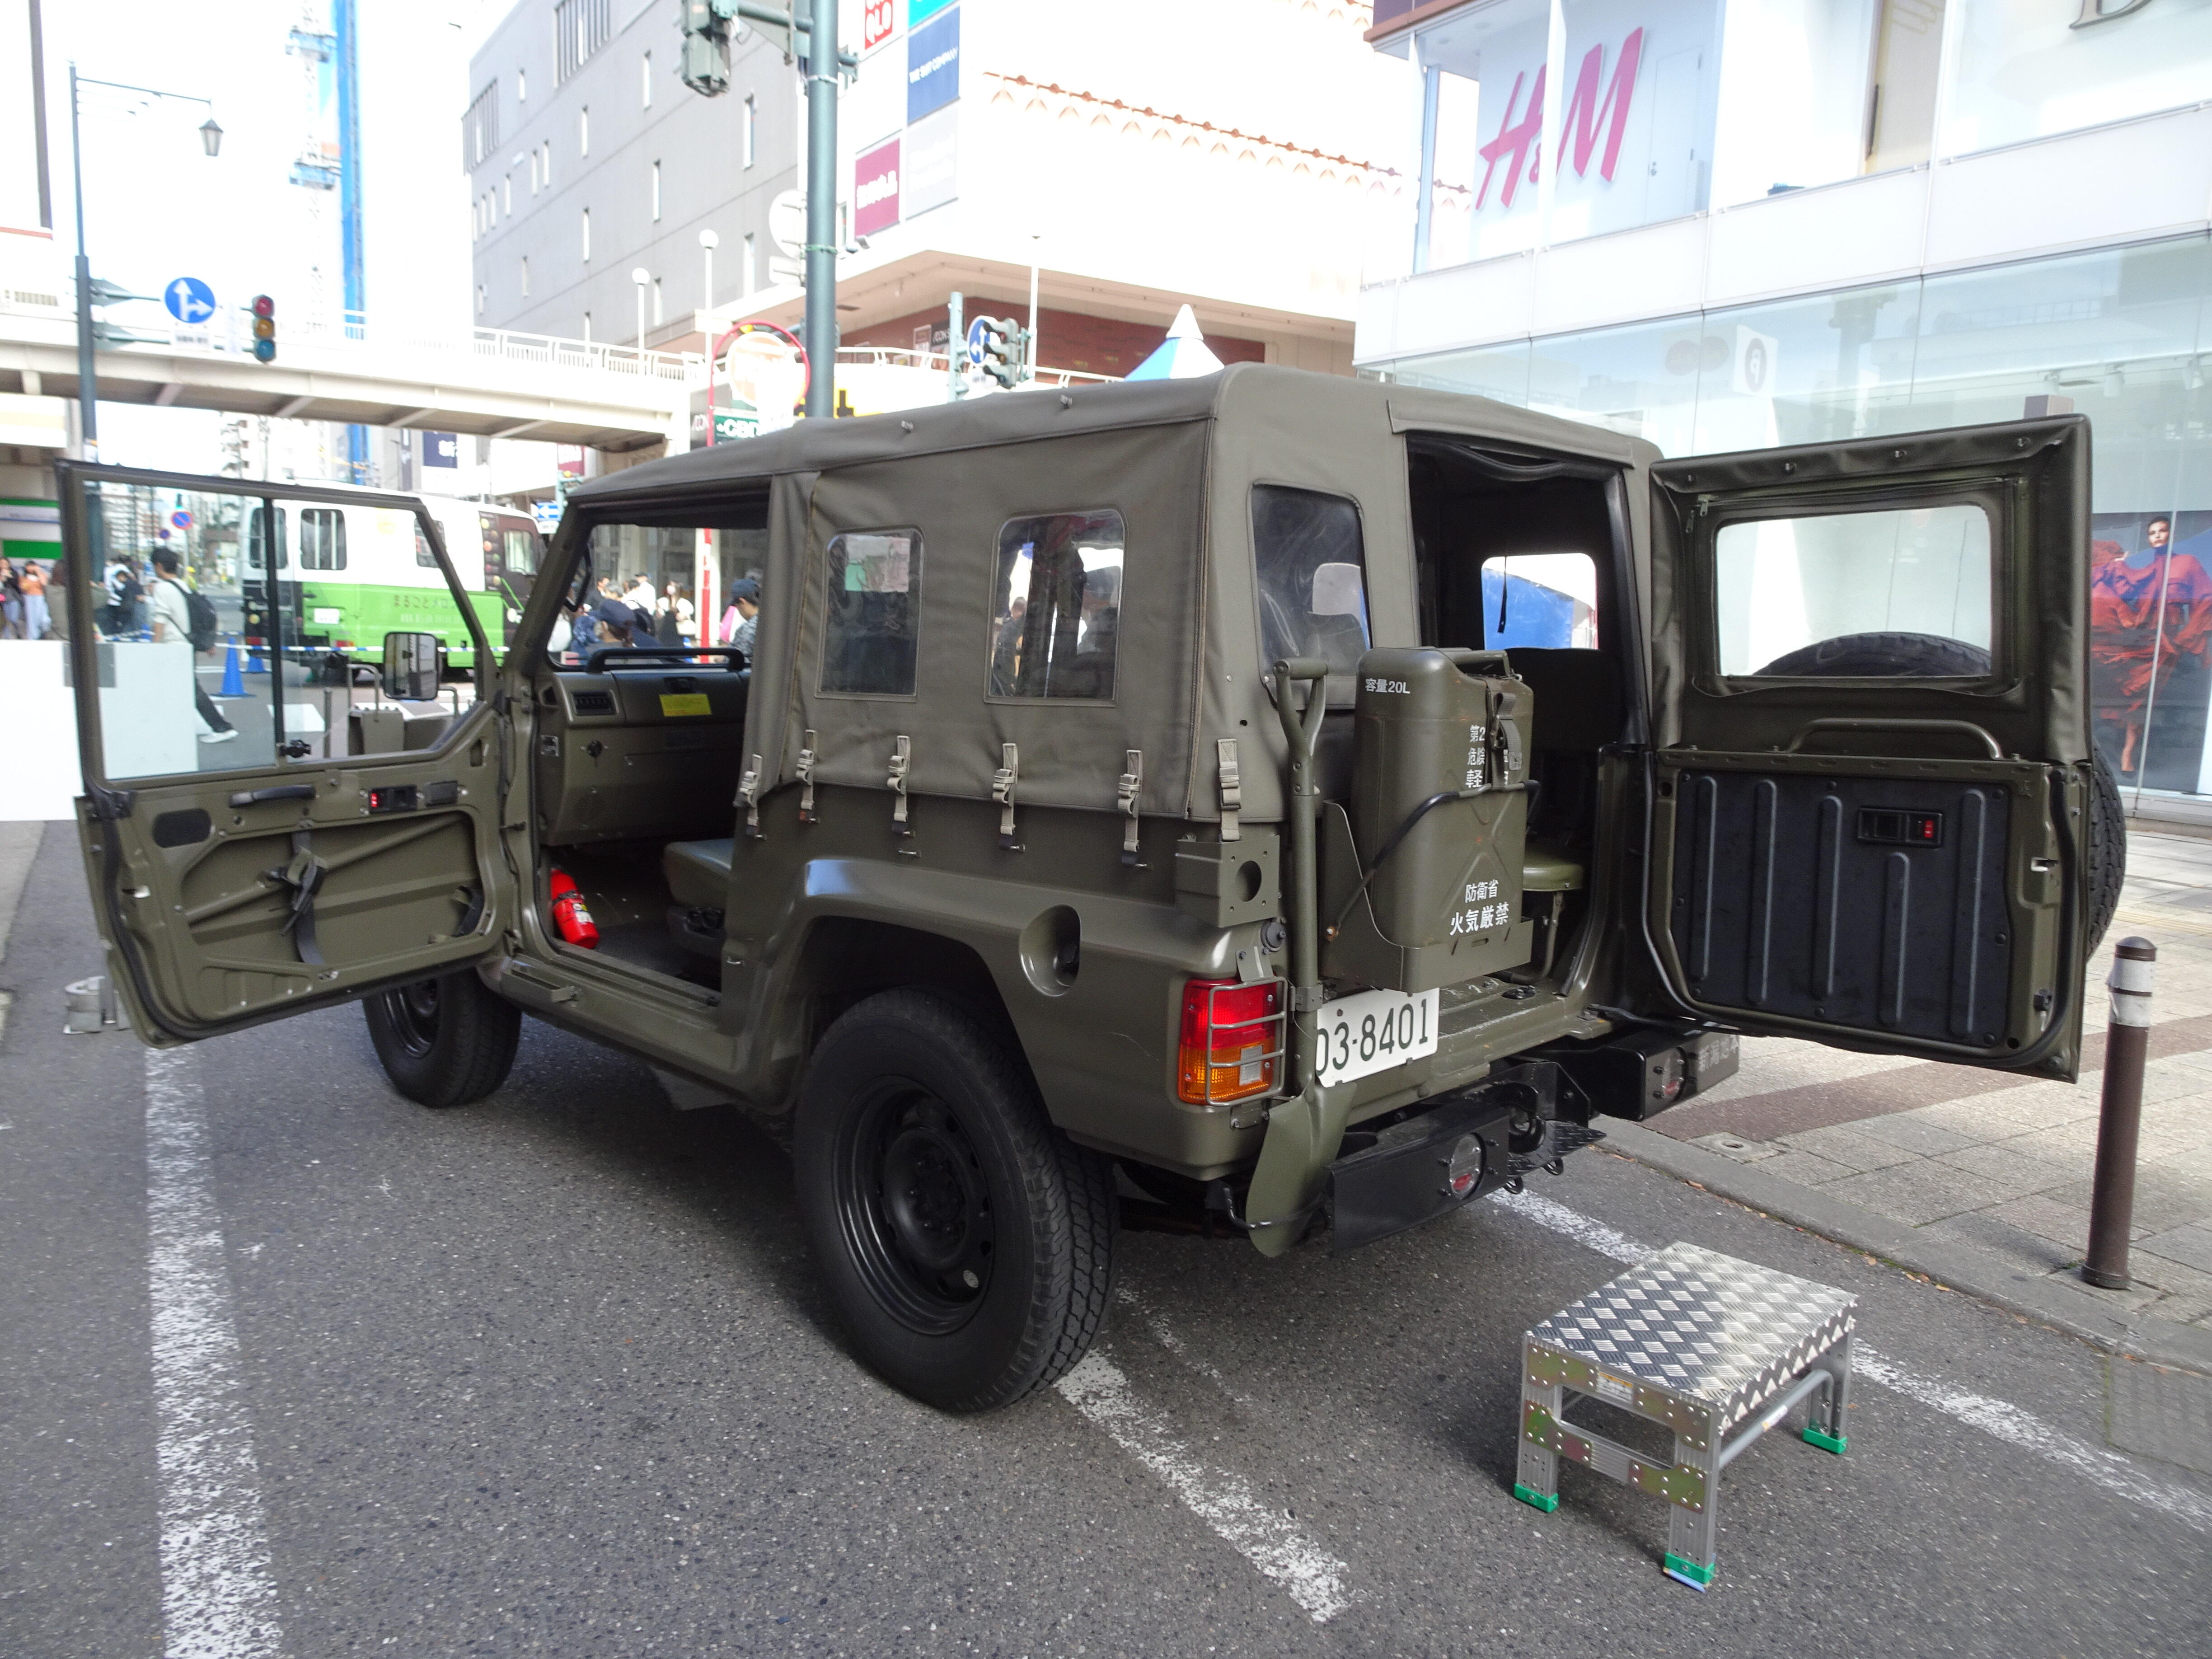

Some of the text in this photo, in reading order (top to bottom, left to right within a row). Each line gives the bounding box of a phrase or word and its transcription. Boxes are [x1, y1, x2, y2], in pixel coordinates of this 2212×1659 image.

[1476, 26, 1644, 211] H&M
[1365, 677, 1411, 695] 容量20L
[1465, 879, 1499, 904] 防衛省
[1449, 902, 1510, 936] 火気厳禁
